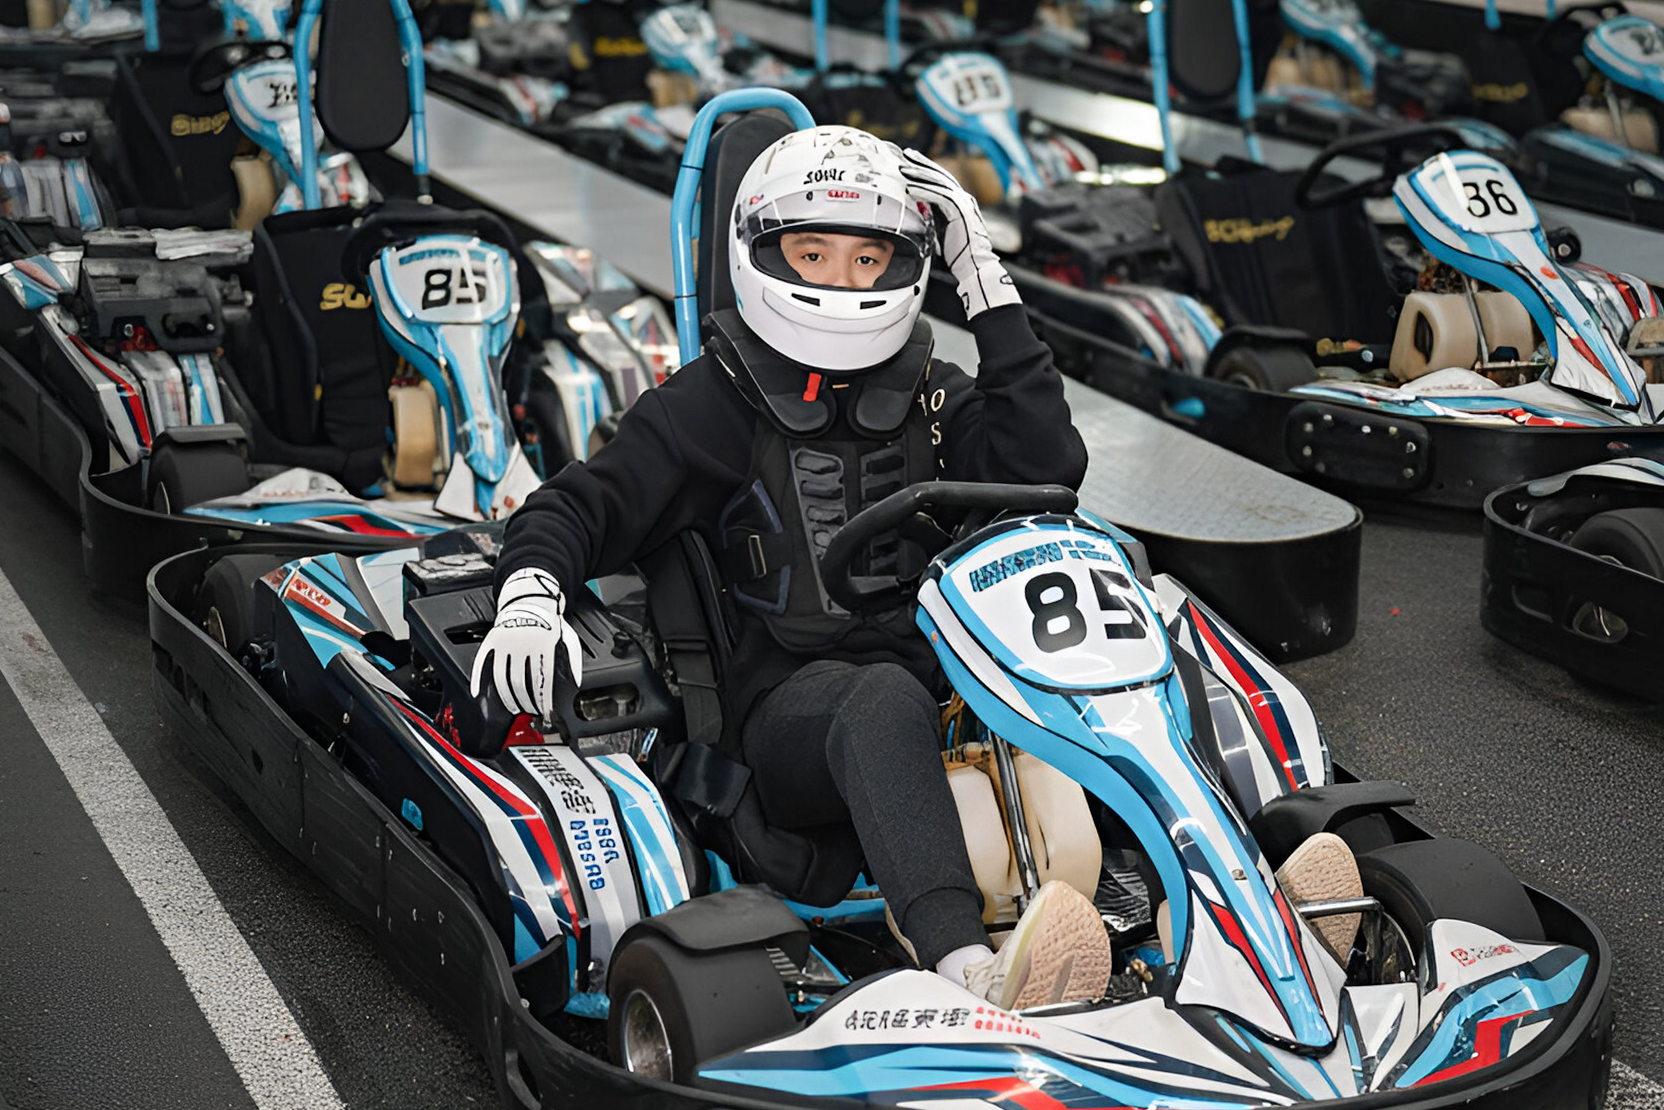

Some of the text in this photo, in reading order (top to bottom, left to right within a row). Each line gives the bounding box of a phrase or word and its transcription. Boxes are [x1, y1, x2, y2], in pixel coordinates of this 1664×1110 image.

[1462, 179, 1518, 217] 36
[422, 268, 487, 310] 85
[1024, 567, 1149, 653] 85
